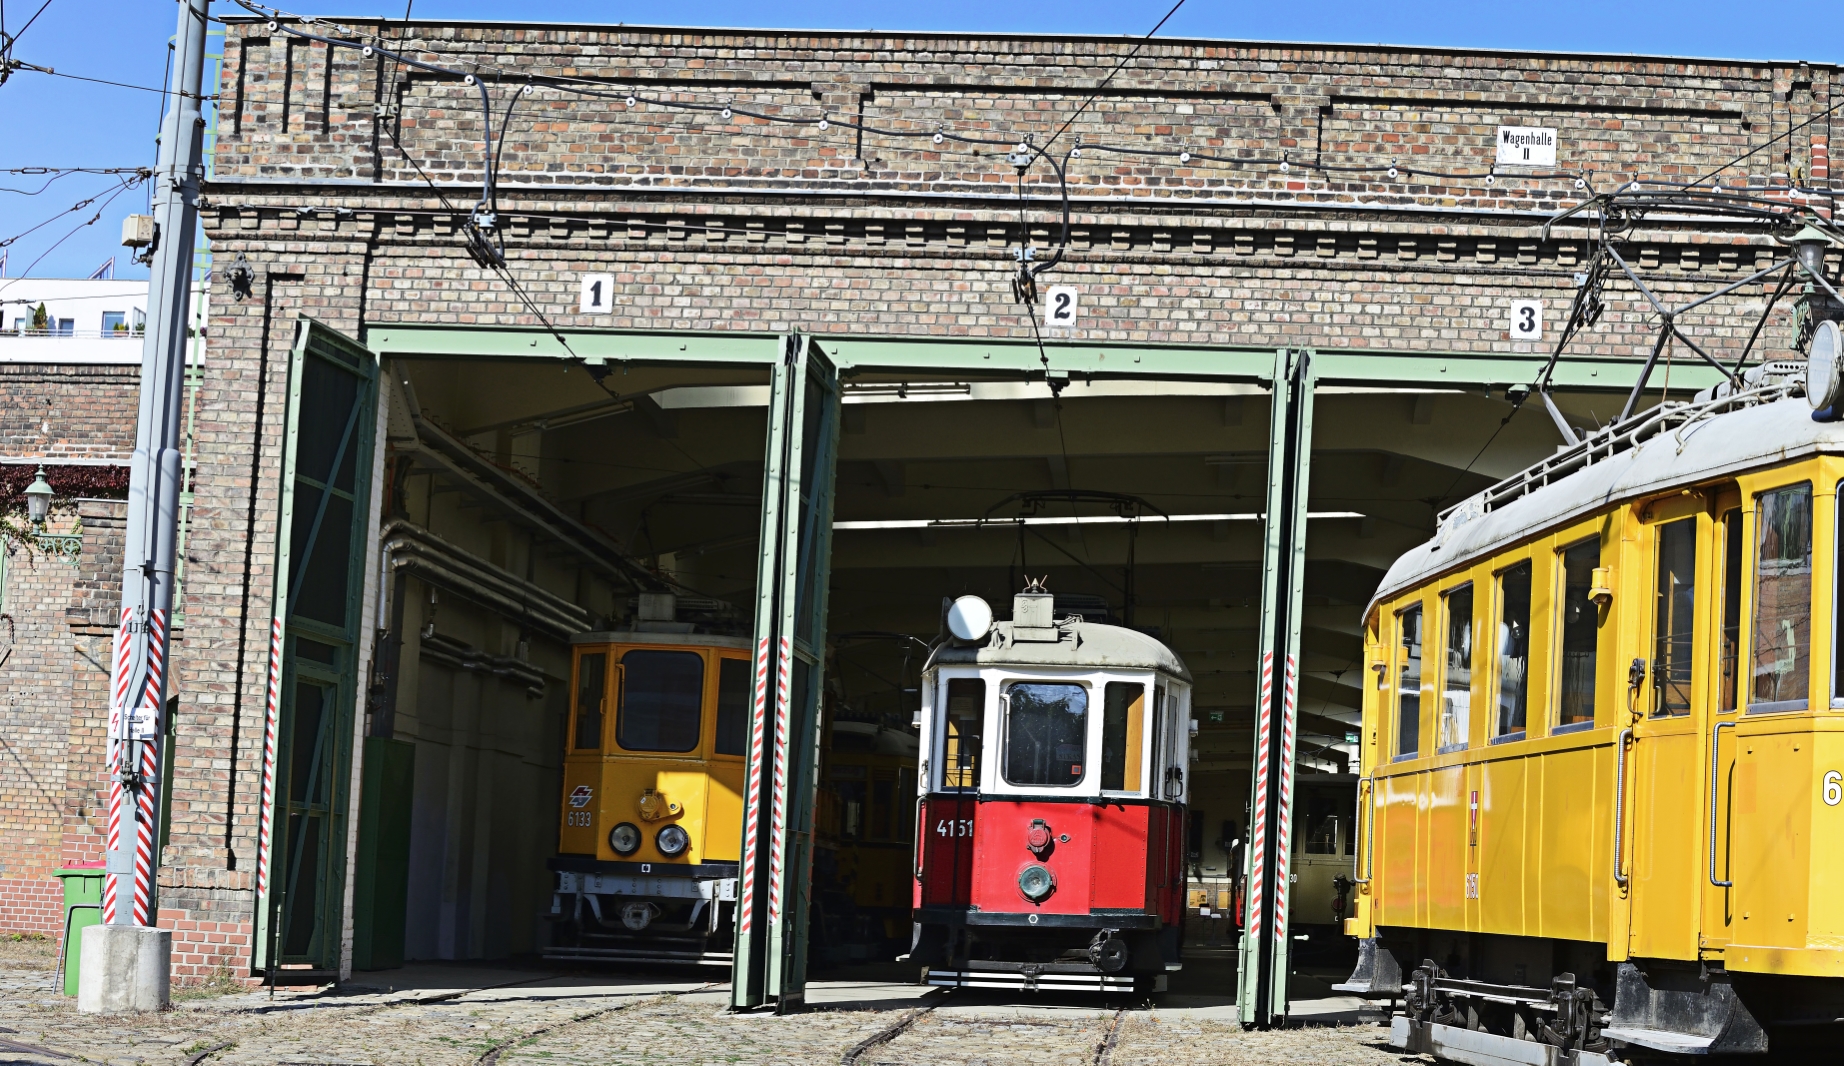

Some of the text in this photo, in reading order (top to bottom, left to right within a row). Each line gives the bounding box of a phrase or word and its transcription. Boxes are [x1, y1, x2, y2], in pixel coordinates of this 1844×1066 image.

[1503, 130, 1552, 148] Wagenhalle
[1523, 148, 1530, 160] II
[590, 281, 602, 306] 1
[1054, 293, 1070, 319] 2
[1519, 306, 1535, 333] 3
[567, 811, 592, 827] 6133
[936, 819, 973, 837] 4151
